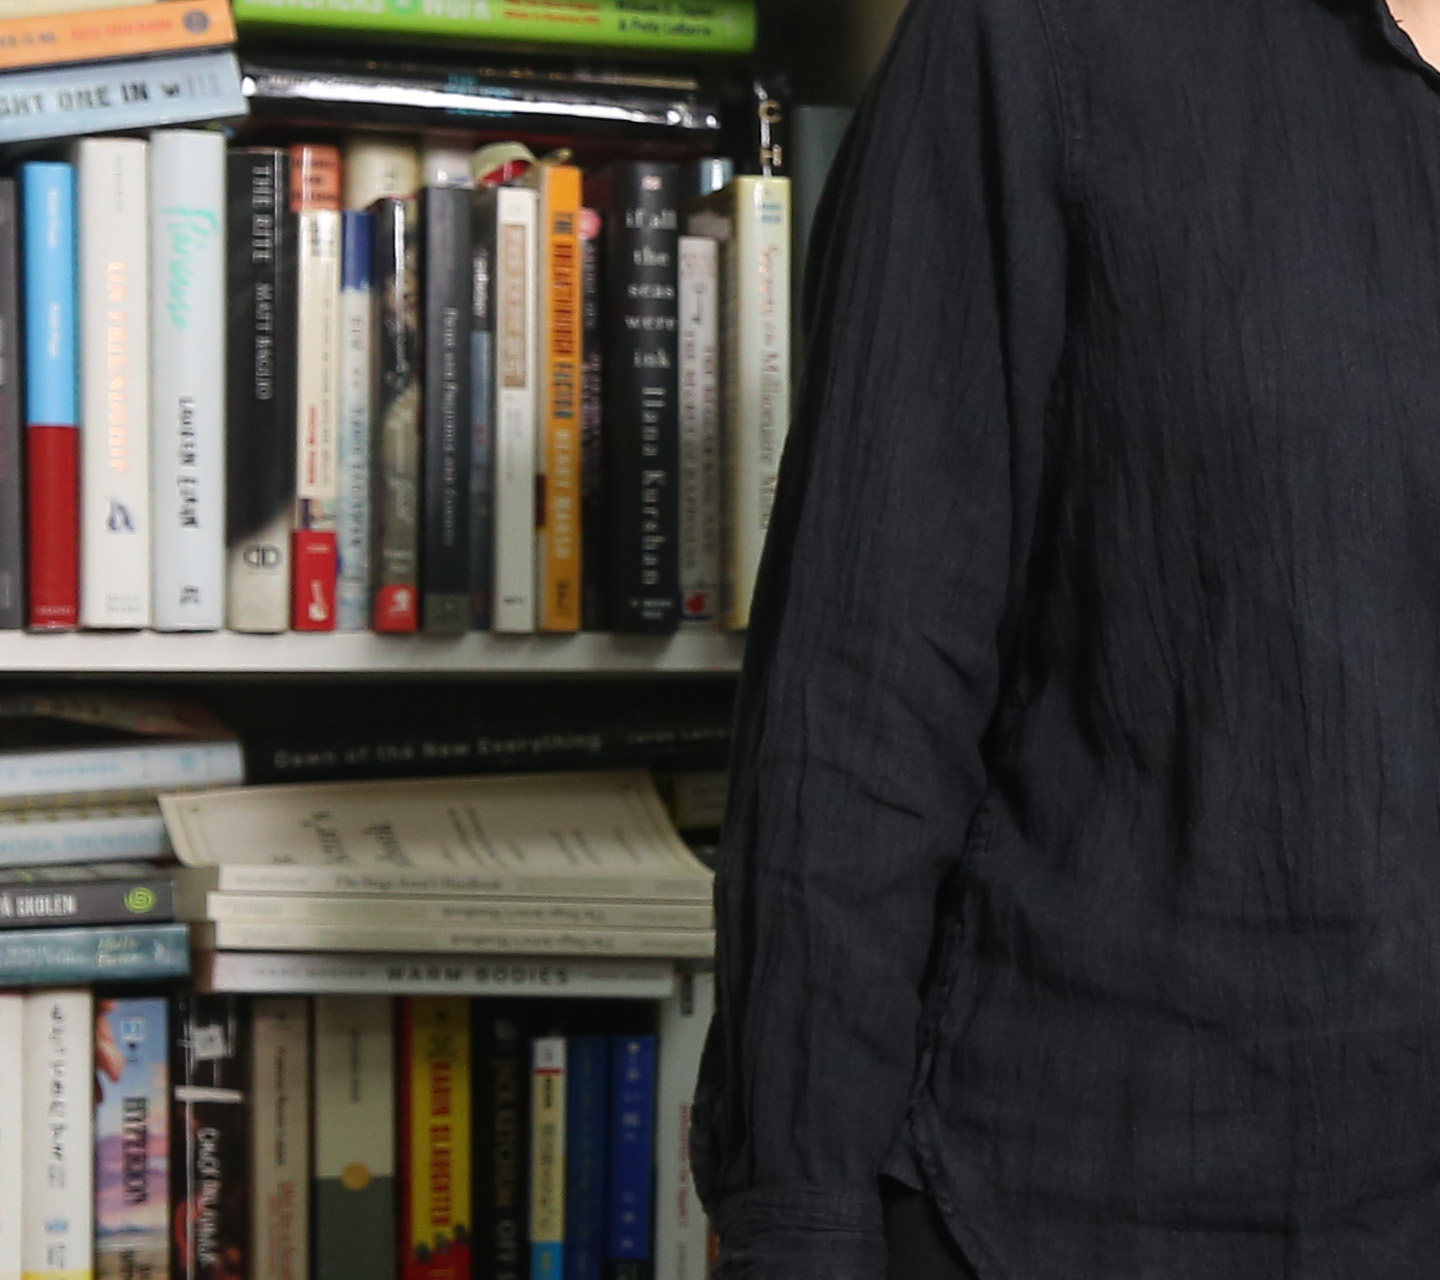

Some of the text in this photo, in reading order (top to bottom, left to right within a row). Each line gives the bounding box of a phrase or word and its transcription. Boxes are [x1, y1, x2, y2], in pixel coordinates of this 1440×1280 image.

[252, 165, 272, 263] THE RITE
[553, 211, 574, 235] THE
[623, 210, 678, 231] if all
[632, 250, 671, 266] the
[254, 282, 272, 331] MATT
[628, 283, 674, 299] seas
[625, 315, 675, 331] were
[108, 261, 129, 473] ON FRIENDSHIP
[633, 349, 673, 369] ink
[177, 396, 196, 466] LAUREN
[758, 350, 779, 466] Millionaire
[642, 385, 669, 585] Ilana Kurshan
[122, 1097, 150, 1206] HYPERION
